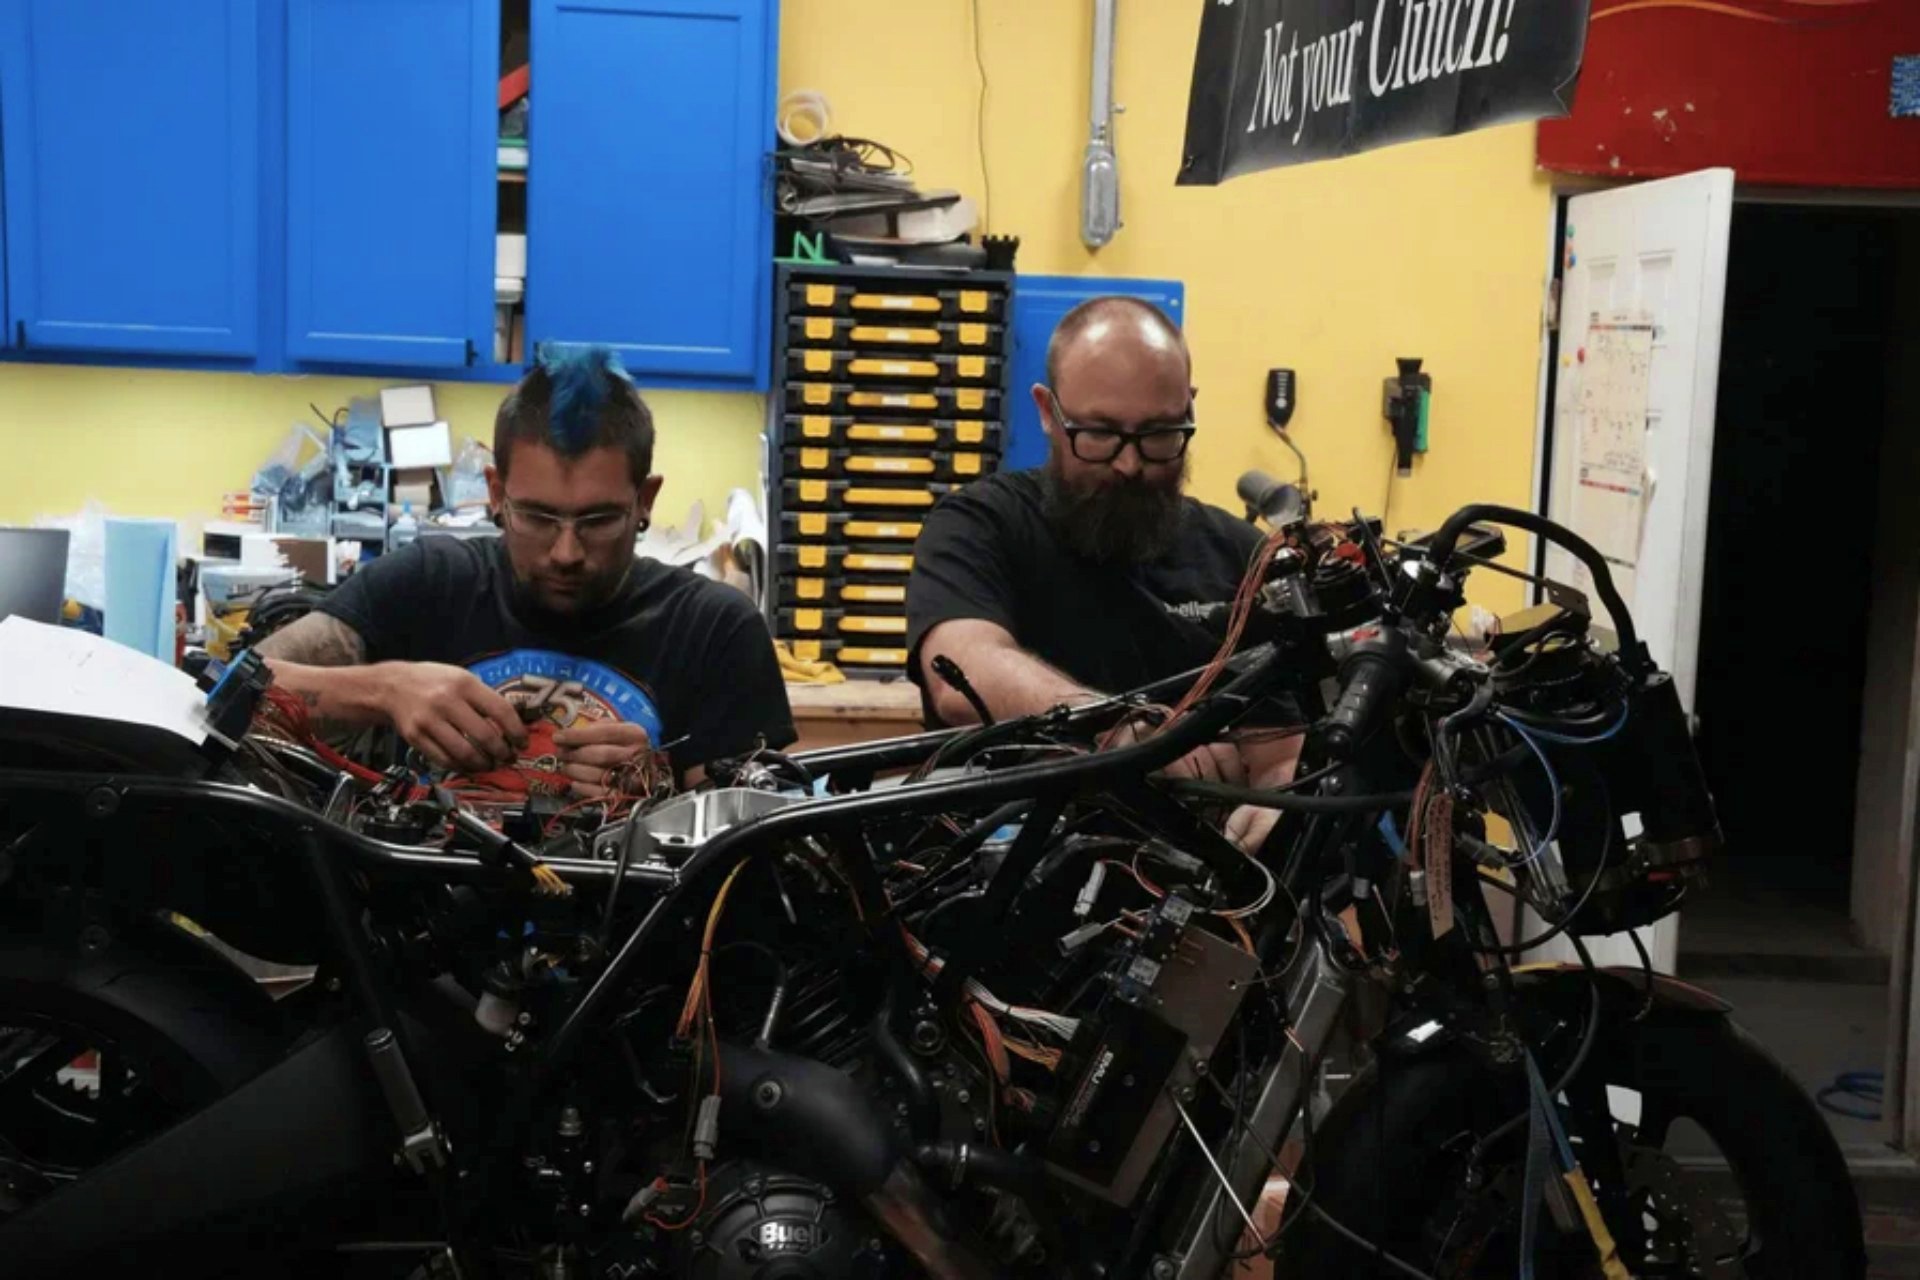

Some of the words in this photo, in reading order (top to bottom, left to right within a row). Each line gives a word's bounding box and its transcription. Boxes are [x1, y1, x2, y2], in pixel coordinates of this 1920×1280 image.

[1246, 20, 1299, 133] Not
[1291, 20, 1364, 146] your
[759, 1221, 823, 1246] Buell
